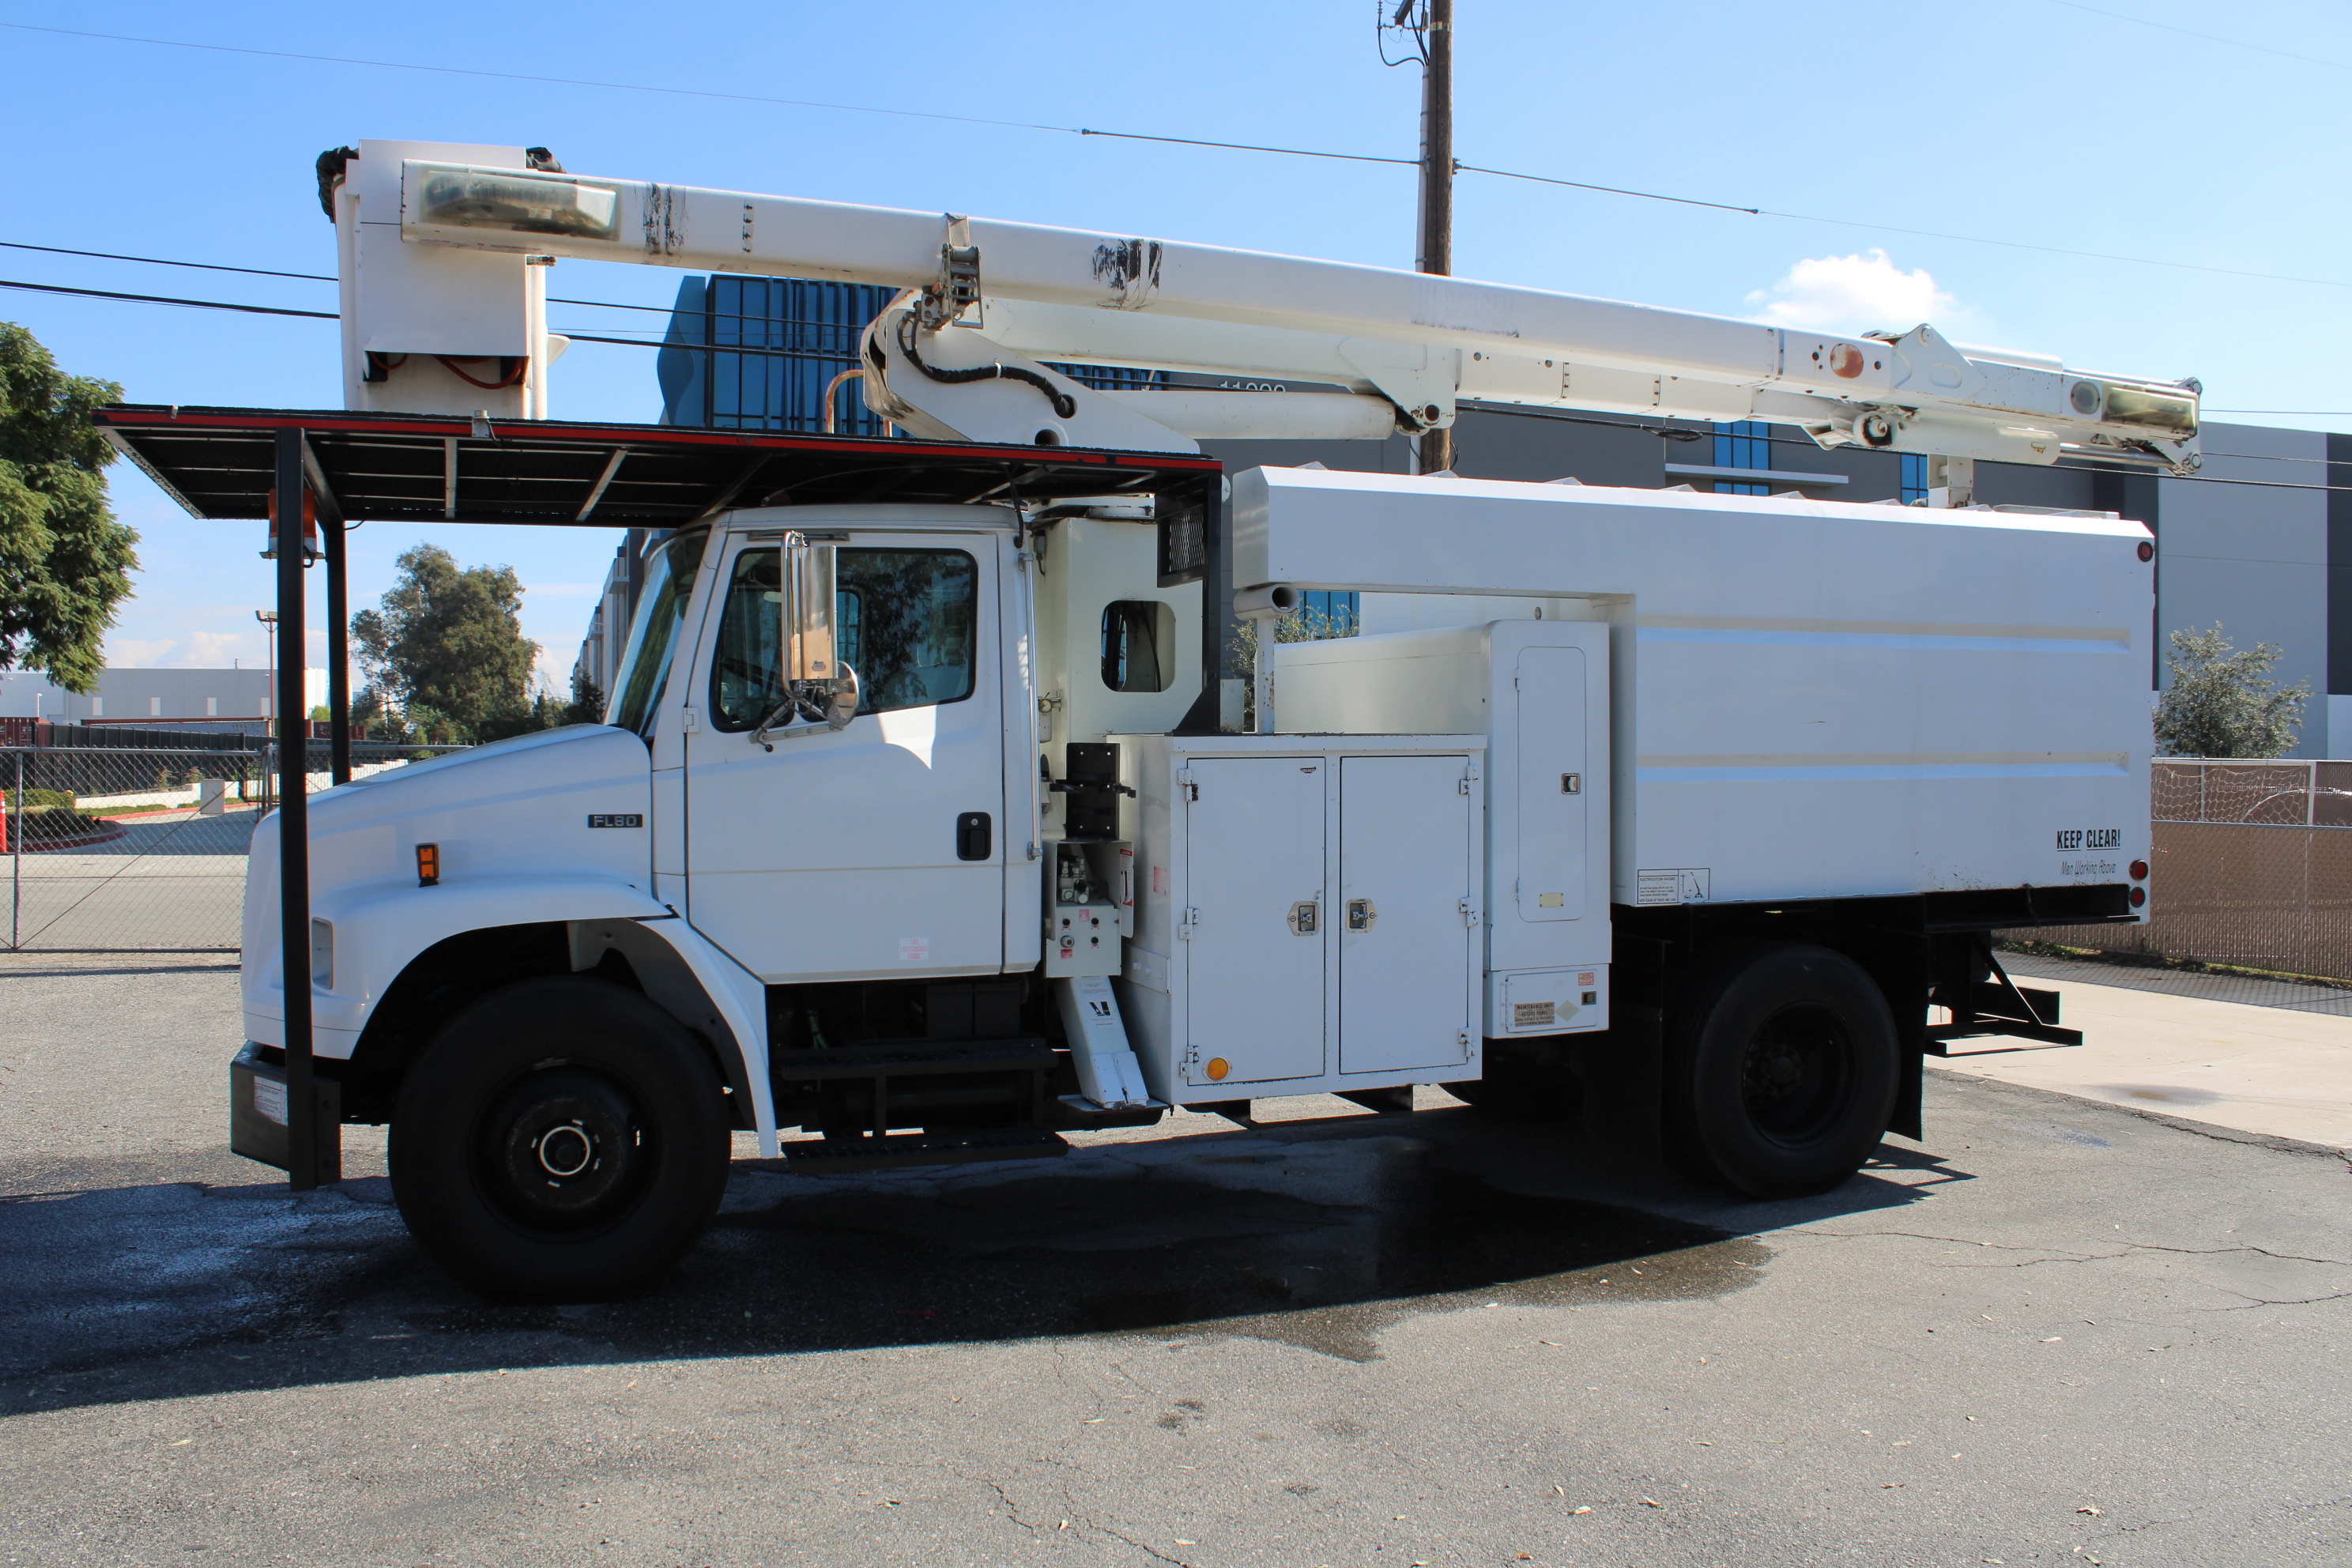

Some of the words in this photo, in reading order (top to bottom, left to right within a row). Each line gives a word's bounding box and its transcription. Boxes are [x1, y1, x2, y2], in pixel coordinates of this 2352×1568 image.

[594, 816, 636, 827] FL80
[2056, 830, 2082, 849] KEEP
[2086, 829, 2120, 848] CLEAR!
[2060, 861, 2073, 875] Men
[2075, 860, 2097, 881] Working
[2098, 859, 2116, 874] Above
